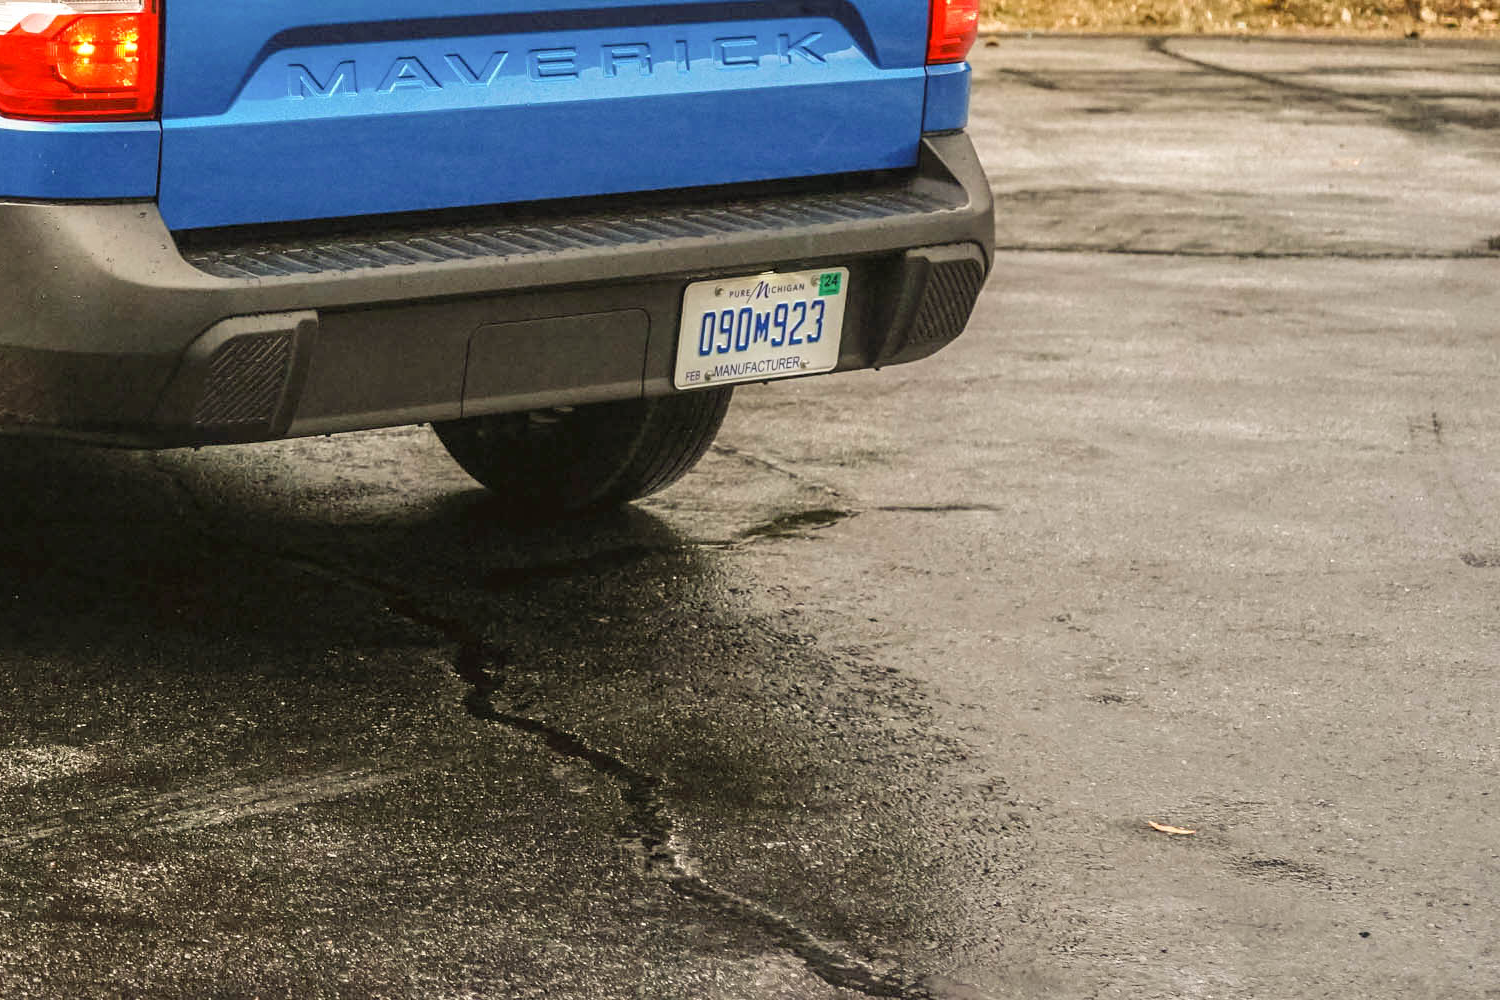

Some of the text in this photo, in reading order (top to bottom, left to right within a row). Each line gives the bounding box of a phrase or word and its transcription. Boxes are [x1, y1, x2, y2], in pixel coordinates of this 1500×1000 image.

[287, 31, 828, 100] MAVERICK
[729, 280, 805, 304] PURE MICHIGAN
[699, 299, 825, 357] 090M923
[685, 356, 800, 382] FEB MANUFACTURER
